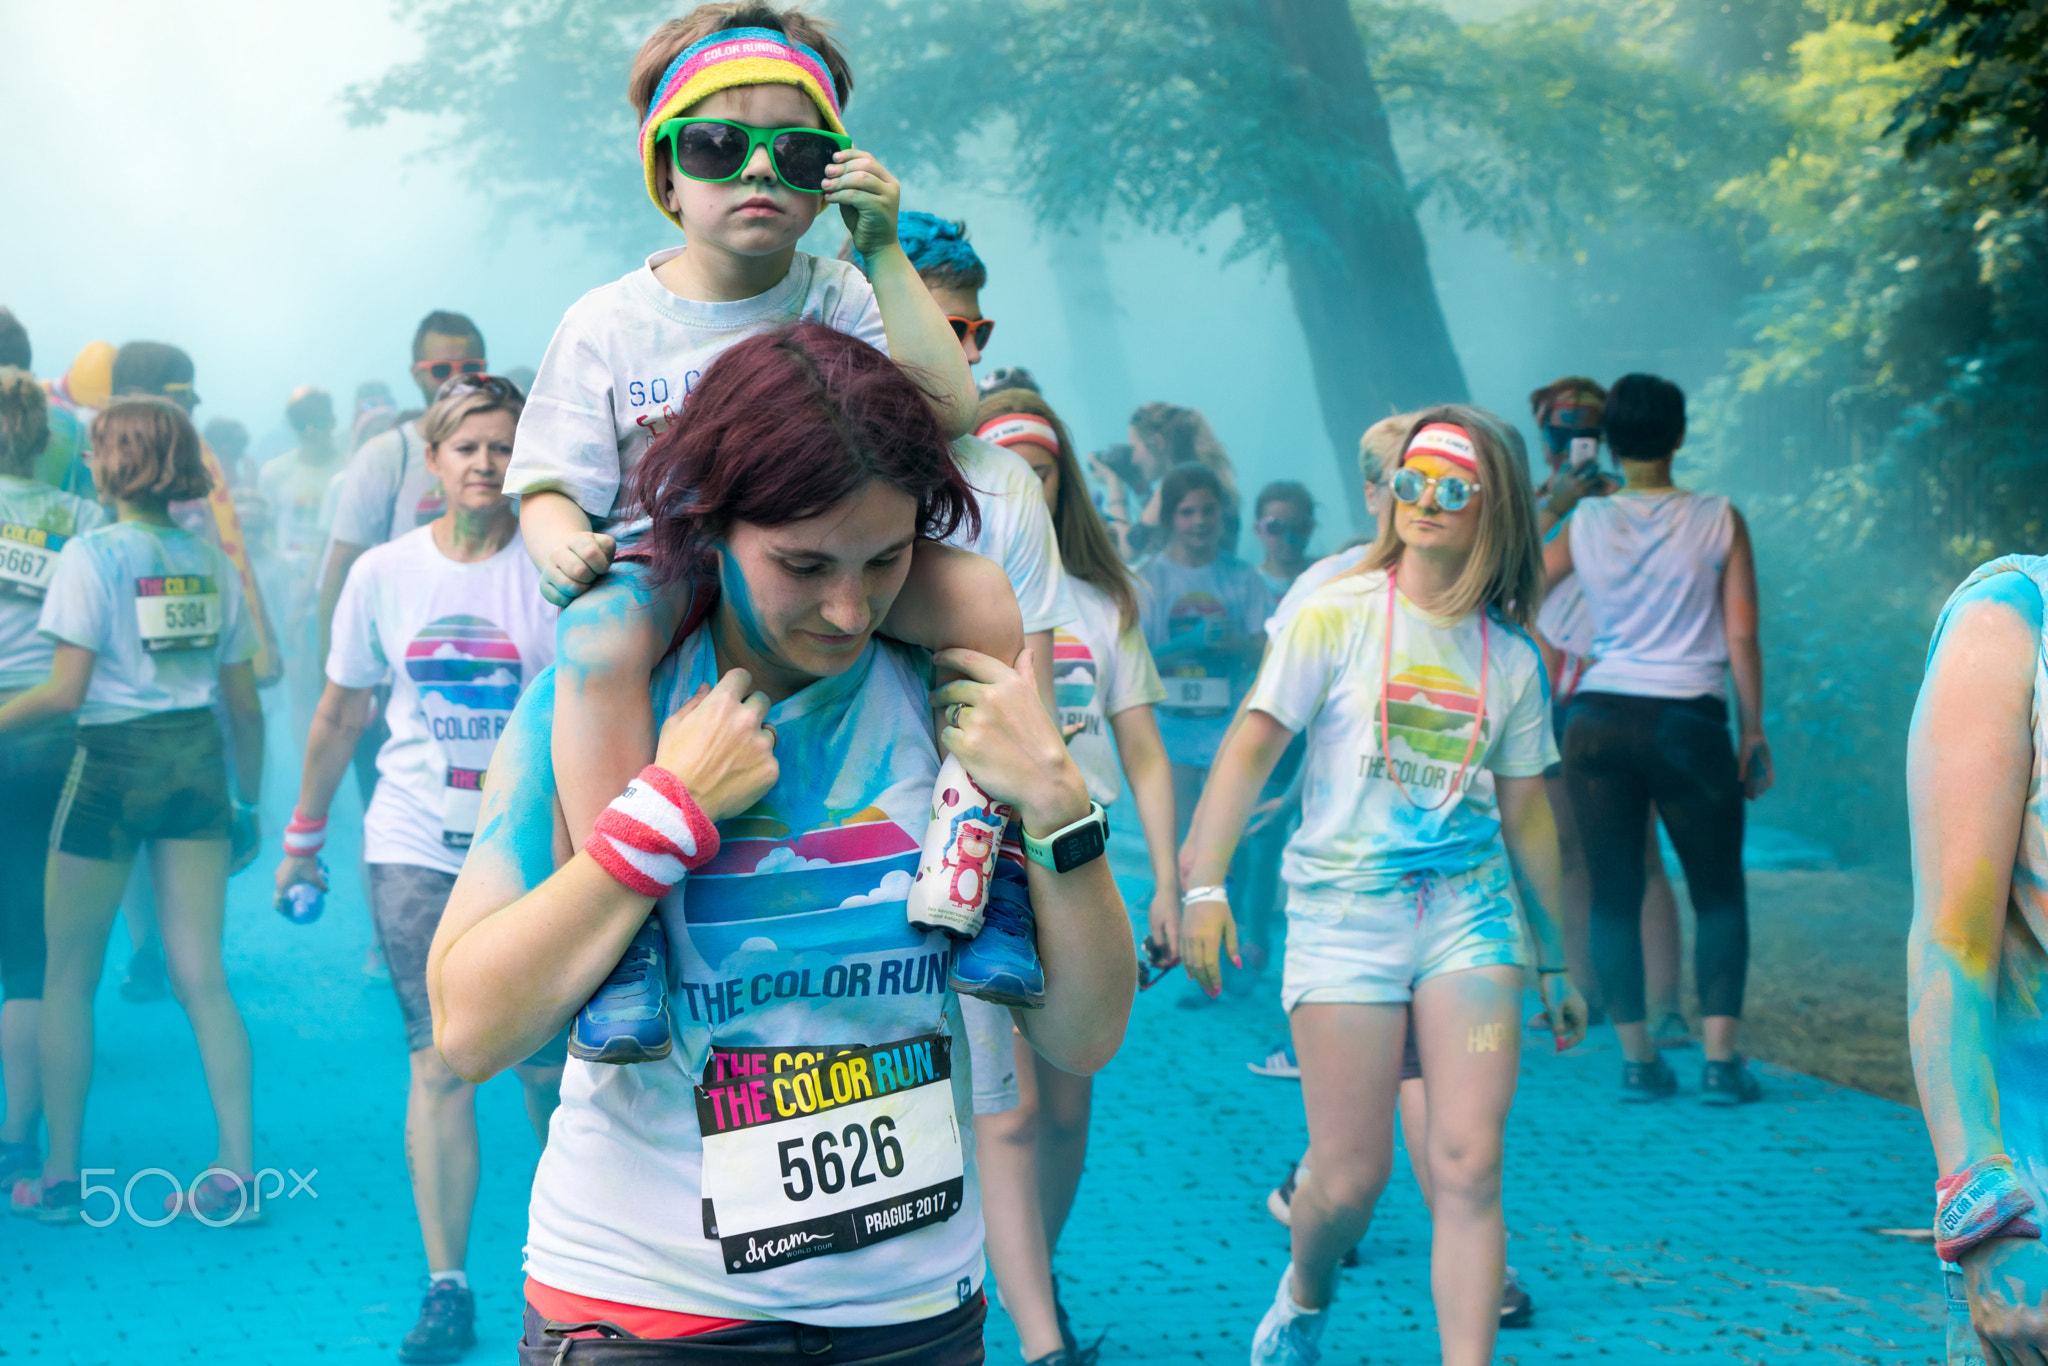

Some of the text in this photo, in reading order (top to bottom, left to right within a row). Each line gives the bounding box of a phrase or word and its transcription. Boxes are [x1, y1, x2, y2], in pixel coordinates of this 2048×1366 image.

[704, 43, 788, 62] COLOR RUNNER
[165, 602, 206, 628] 5304
[433, 716, 491, 741] COLOR
[451, 768, 479, 790] THE
[1358, 755, 1386, 779] THE
[1387, 758, 1447, 790] COLOR
[681, 951, 949, 1024] THE COLOR RUN
[714, 1052, 767, 1082] THE
[707, 1080, 772, 1131] THE
[773, 1057, 873, 1117] COLOR
[777, 1115, 905, 1202] 5626
[745, 1191, 947, 1264] dream PRAGUE 2017
[1943, 1197, 1974, 1231] COLOR
[786, 1242, 833, 1258] WORLD TOUR
